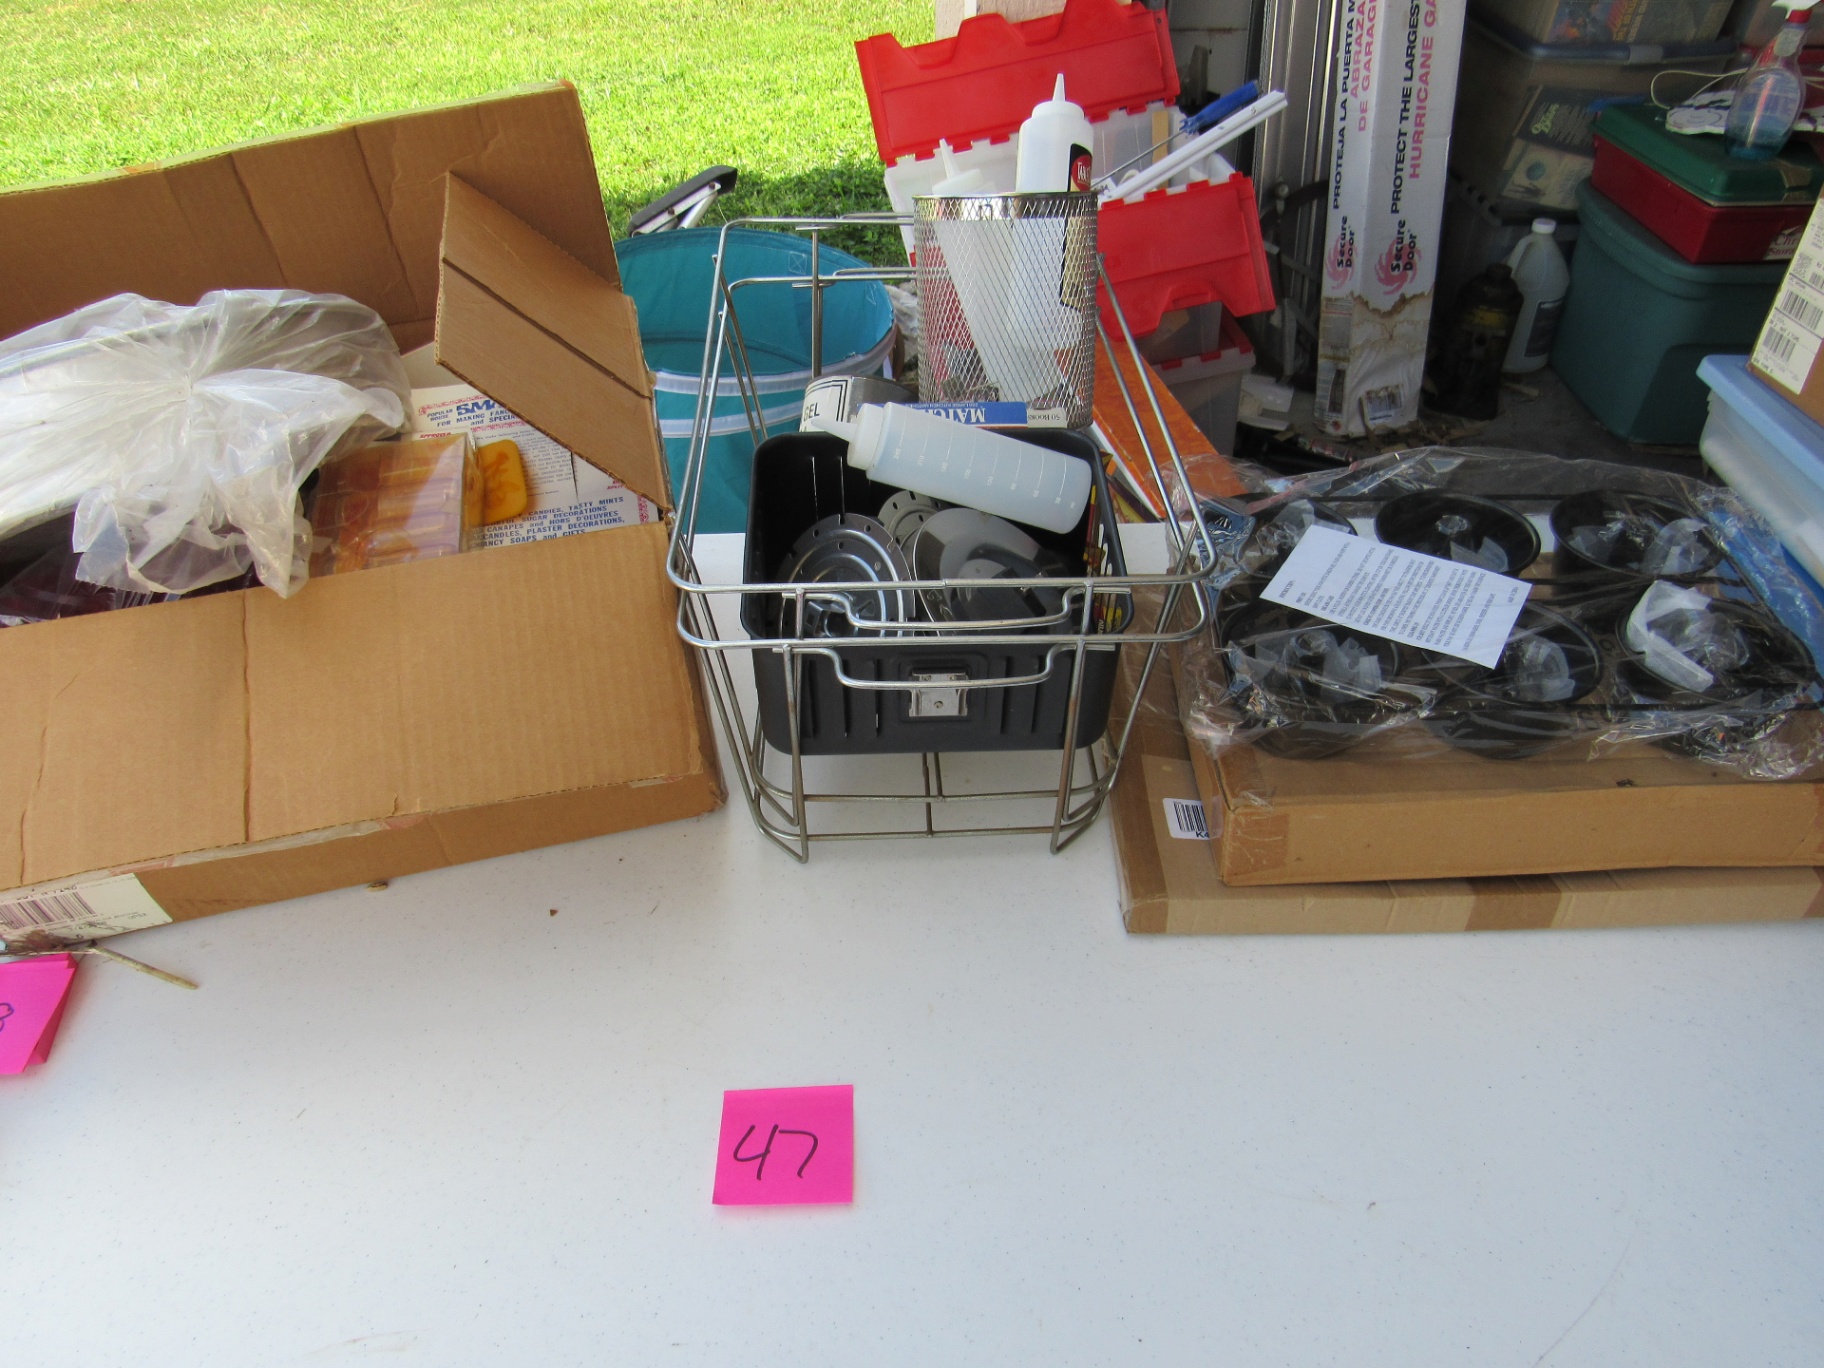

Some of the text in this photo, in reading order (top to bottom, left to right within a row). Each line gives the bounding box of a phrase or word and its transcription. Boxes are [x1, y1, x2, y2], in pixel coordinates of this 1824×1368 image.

[1341, 17, 1355, 93] PUERTA
[1358, 0, 1377, 131] DE GARAG
[1340, 98, 1348, 122] LA
[1409, 36, 1433, 178] HURRICANE
[1333, 126, 1346, 209] PROTEJA
[1391, 128, 1408, 214] PROTECT
[1400, 86, 1412, 123] THE
[1337, 215, 1347, 268] Secure
[1345, 229, 1355, 268] Door
[1391, 219, 1406, 272] Secure
[1403, 233, 1417, 271] Door
[427, 408, 453, 418] POPULAR
[456, 413, 485, 423] MAKING
[489, 414, 518, 423] SPECIA
[522, 515, 548, 523] SUGAR
[553, 506, 608, 518] DECORATIONS
[549, 517, 570, 525] HORS
[576, 511, 619, 521] D'OEUVRES
[569, 501, 593, 511] TASTY
[599, 496, 624, 505] MINTS
[510, 534, 537, 543] SOAPS
[527, 525, 563, 535] PLASTER
[568, 516, 625, 530] DECORATIONS,
[733, 1124, 819, 1181] 47
